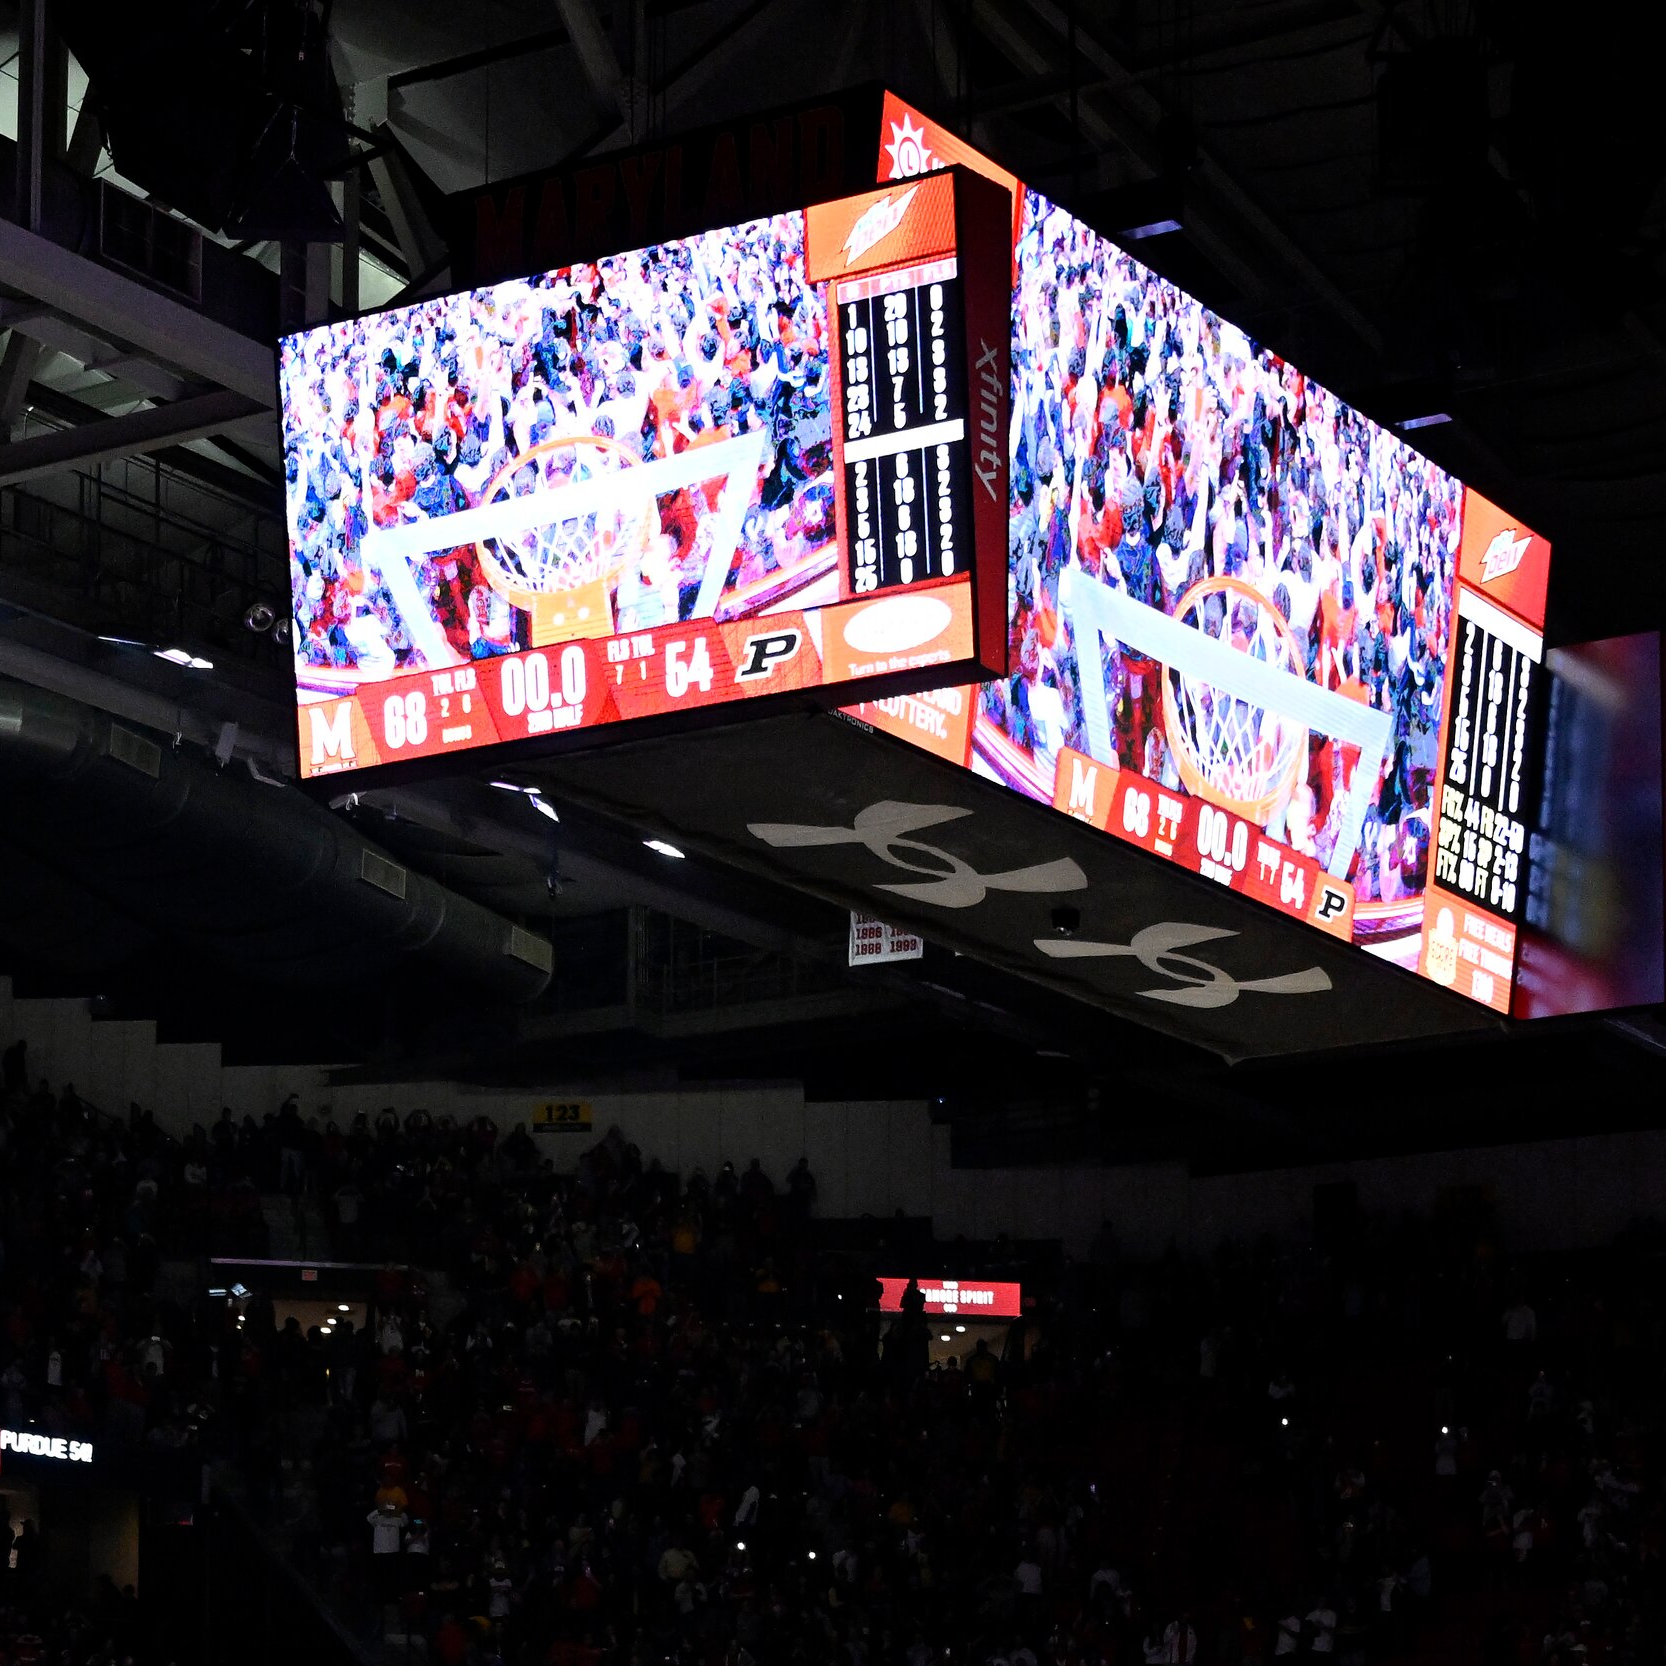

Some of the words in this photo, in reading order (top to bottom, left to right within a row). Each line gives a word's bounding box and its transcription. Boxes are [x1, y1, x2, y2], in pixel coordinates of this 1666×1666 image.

[474, 105, 845, 279] MARYLAND
[975, 338, 1003, 502] xfinity
[501, 646, 585, 716] 00.0
[616, 665, 623, 684] 7
[640, 661, 646, 680] 1
[665, 638, 713, 697] 54
[735, 628, 801, 683] P
[848, 662, 874, 676] Turn
[889, 656, 907, 670] the
[309, 702, 356, 765] M
[384, 692, 427, 748] 68
[441, 698, 449, 718] 2
[1069, 758, 1097, 816] M
[1123, 787, 1150, 837] 68
[1197, 805, 1248, 871] 00.0
[1281, 861, 1304, 909] 54
[1315, 884, 1347, 923] P
[960, 1290, 993, 1304] SPIRIT
[0, 1429, 68, 1460] PURDUE
